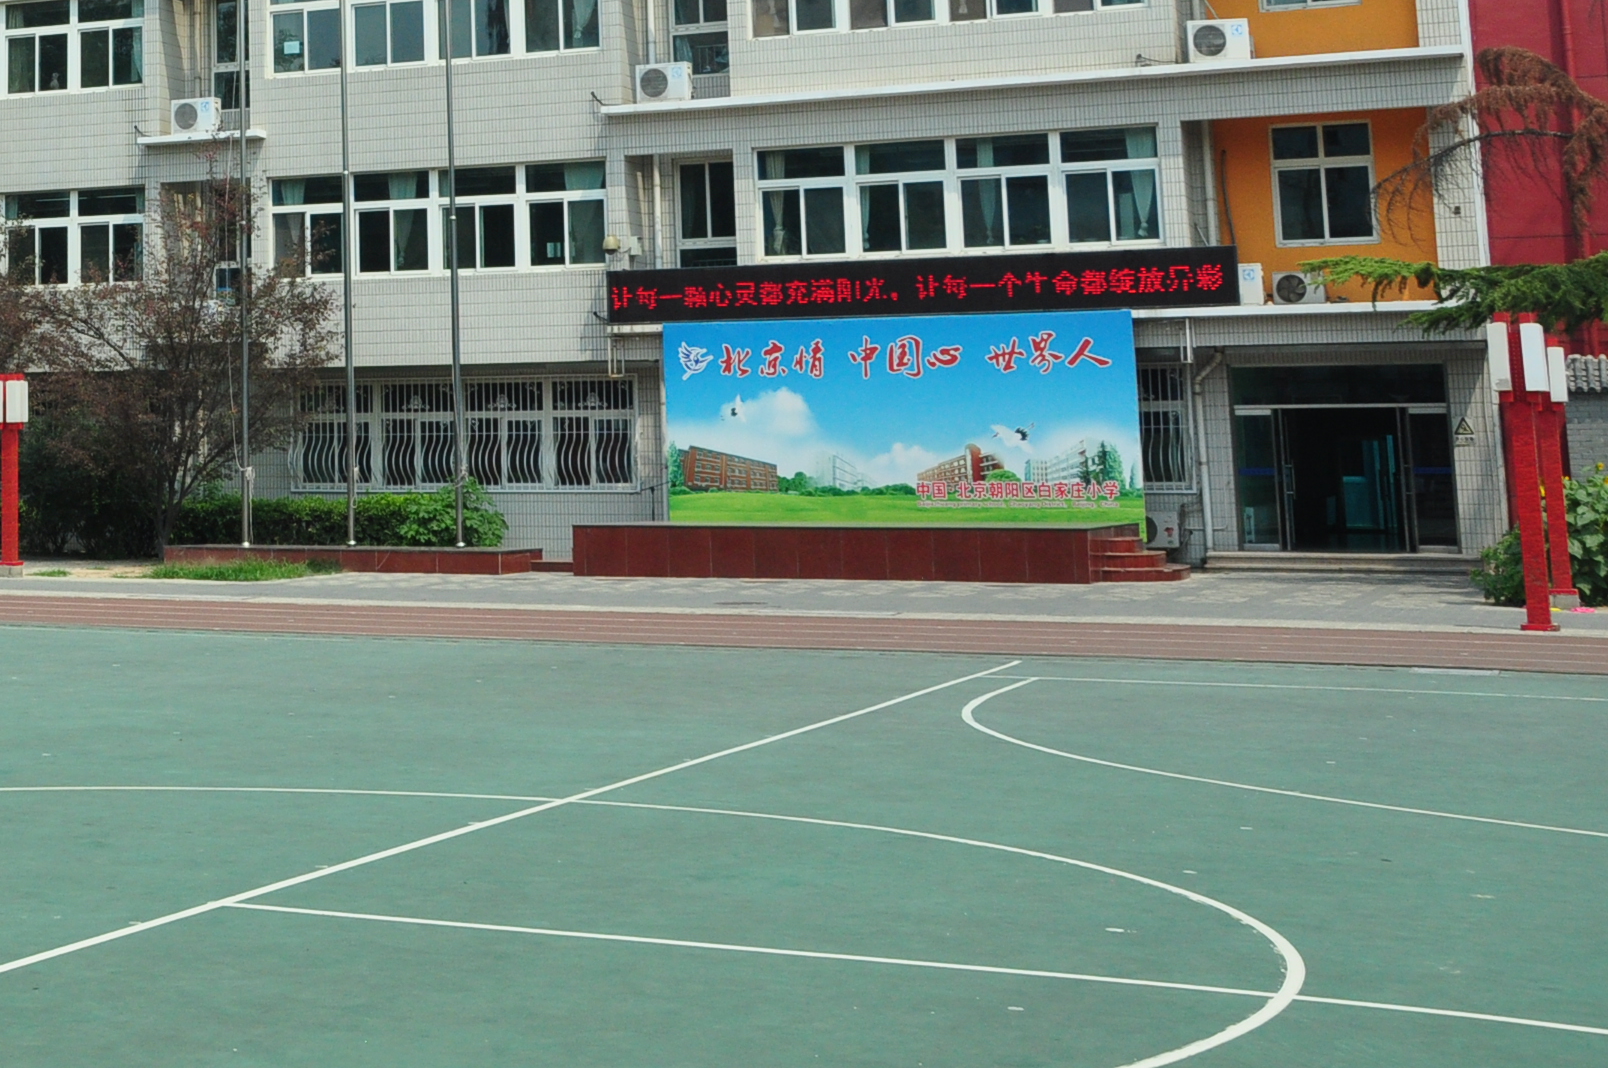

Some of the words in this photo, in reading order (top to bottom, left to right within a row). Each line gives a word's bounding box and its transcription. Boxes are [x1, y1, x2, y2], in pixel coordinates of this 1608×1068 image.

[719, 337, 826, 379] 北京情
[847, 334, 963, 379] 中国心
[985, 330, 1113, 374] 世界人
[916, 480, 1120, 500] 中国·北京朝阳区白家庄小学
